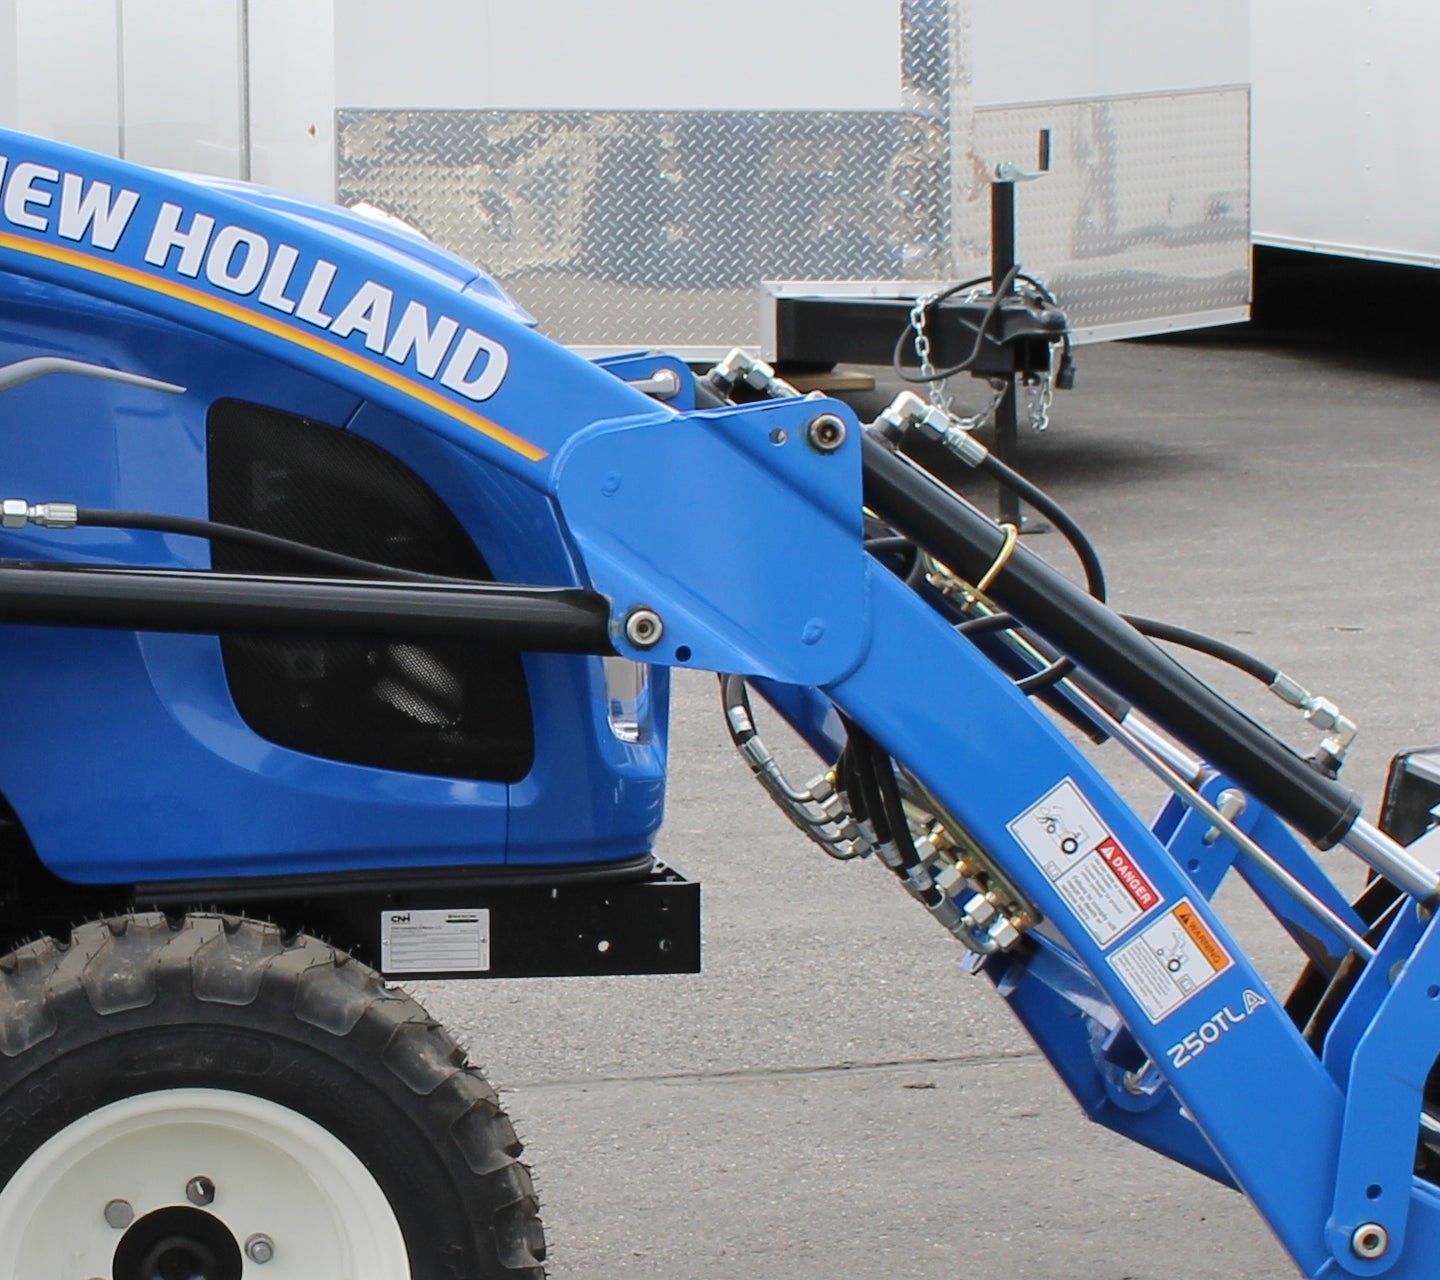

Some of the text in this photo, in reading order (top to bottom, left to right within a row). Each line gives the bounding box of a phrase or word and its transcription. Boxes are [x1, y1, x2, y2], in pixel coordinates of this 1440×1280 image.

[145, 200, 510, 403] HOLLAND
[1112, 857, 1153, 905] DANGER
[391, 914, 410, 923] CNH
[1189, 922, 1221, 964] WARNING
[1166, 989, 1267, 1068] 250TLA
